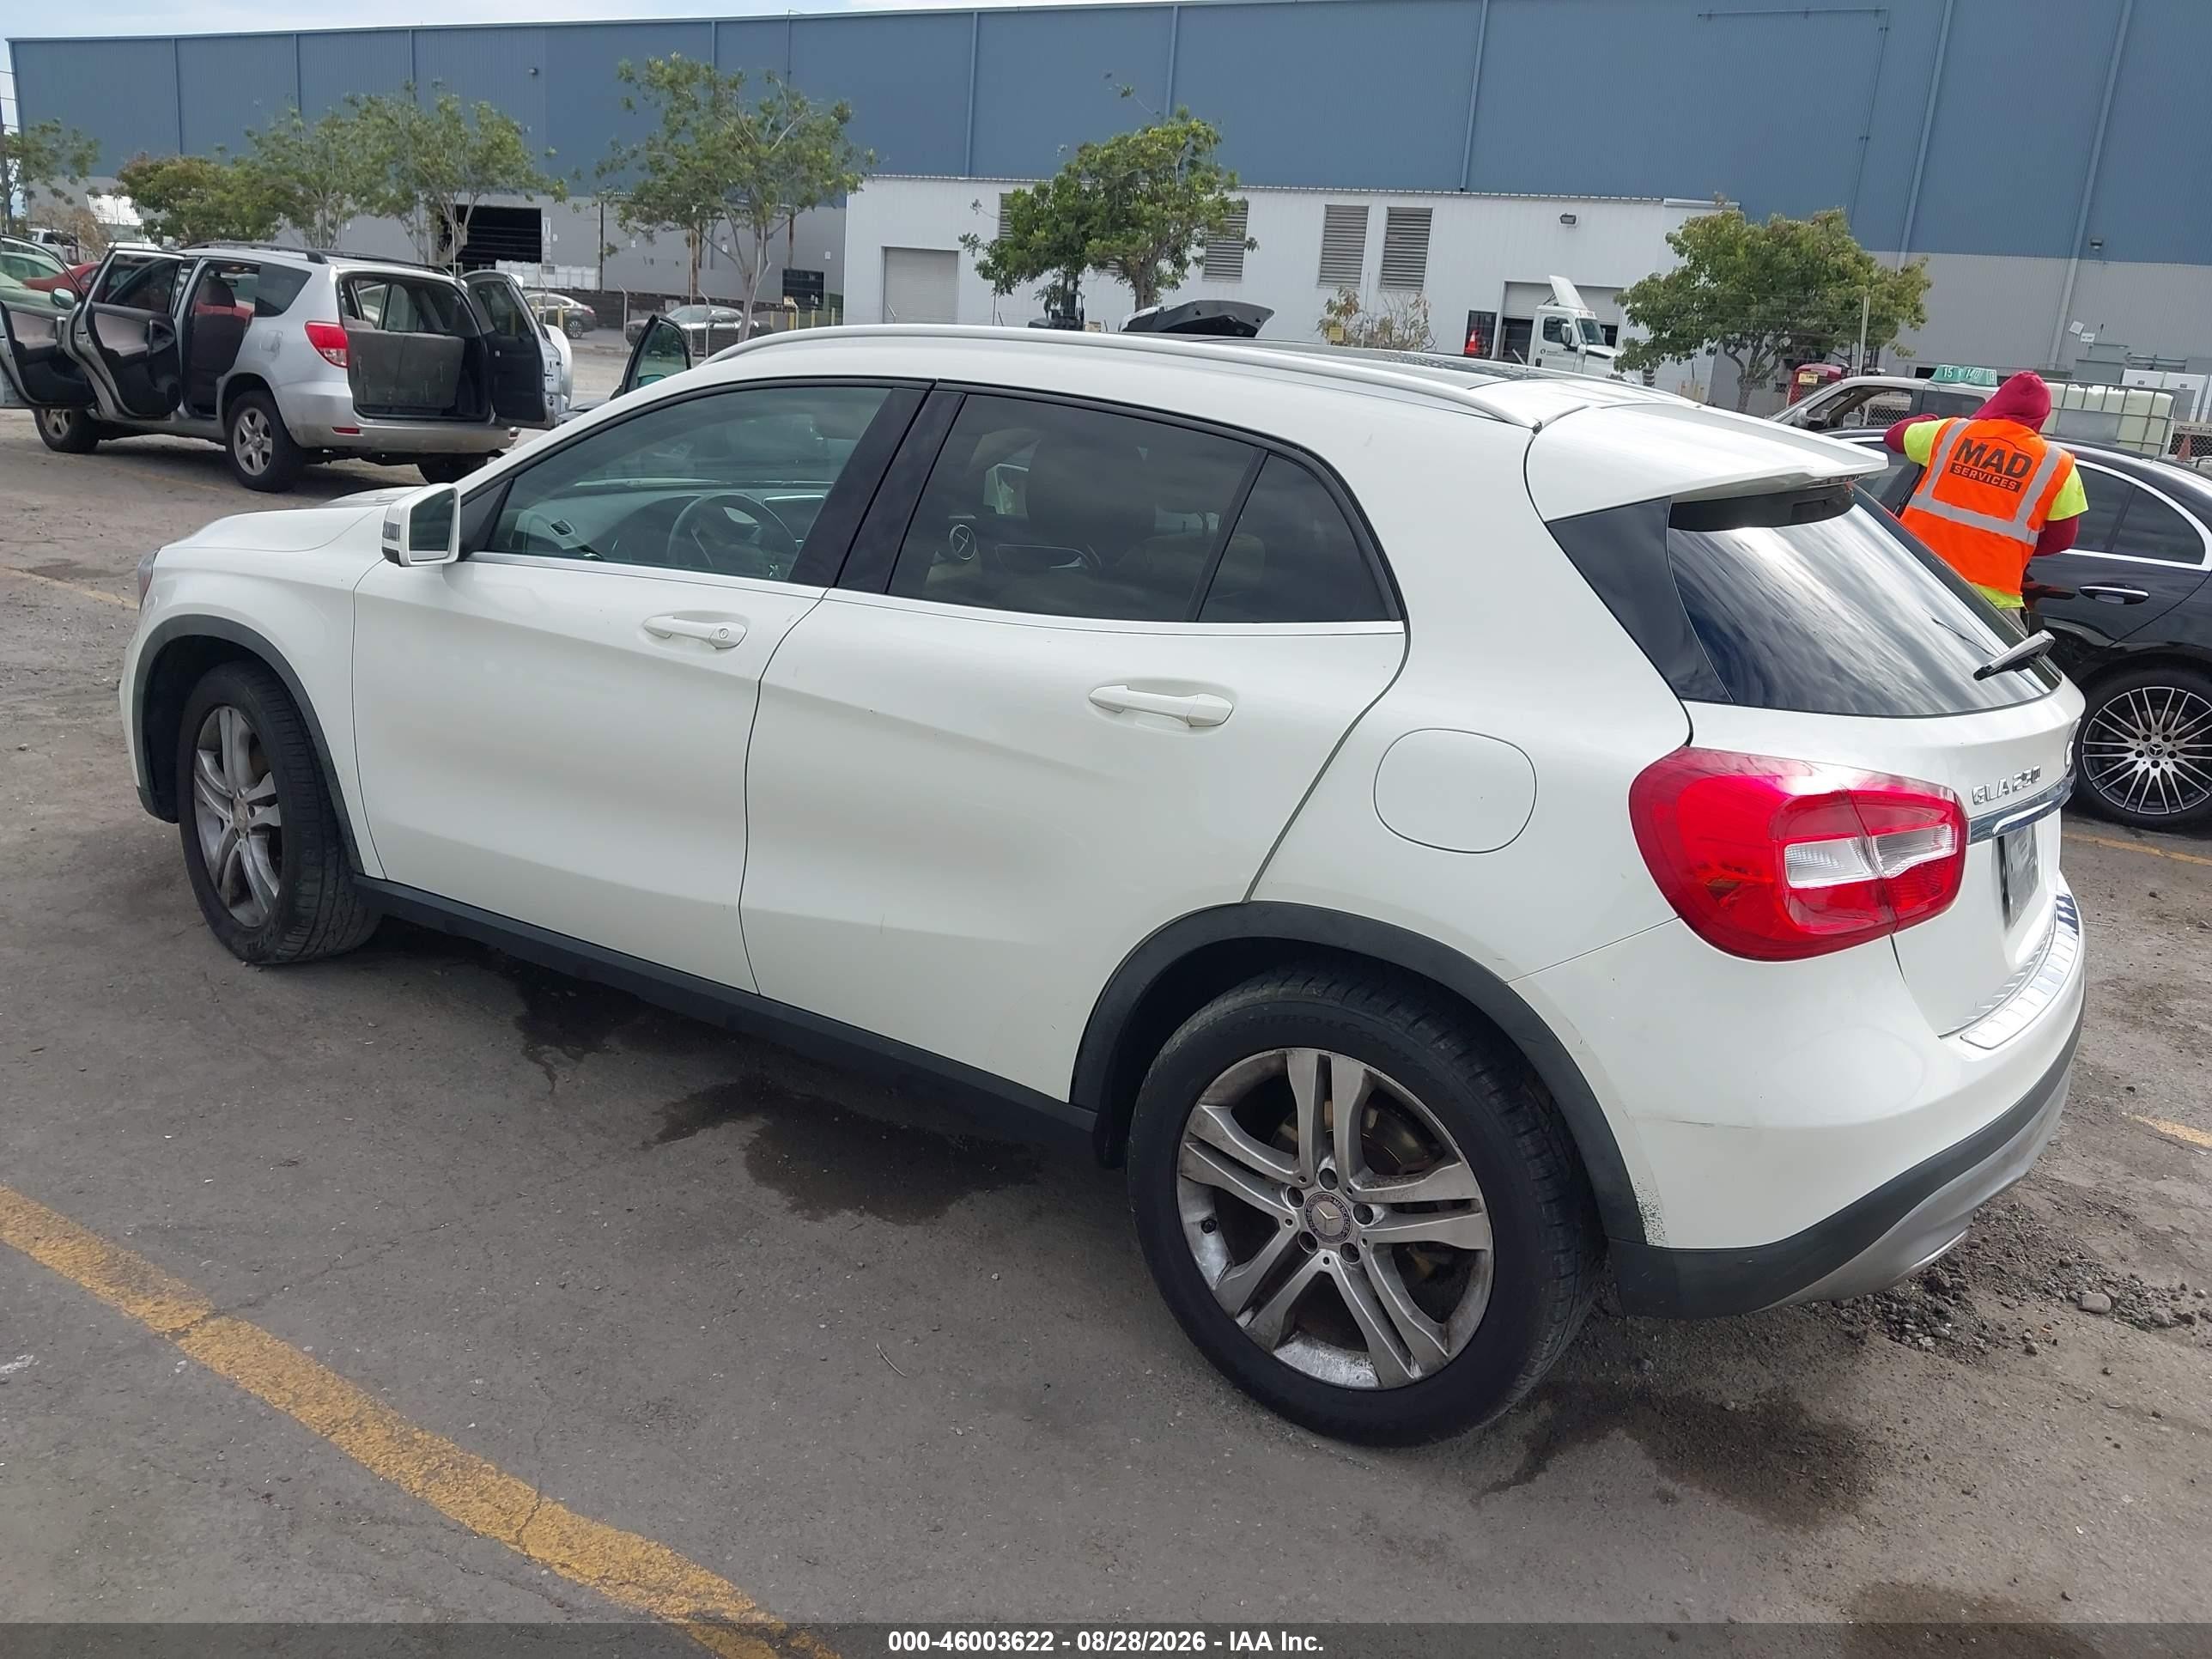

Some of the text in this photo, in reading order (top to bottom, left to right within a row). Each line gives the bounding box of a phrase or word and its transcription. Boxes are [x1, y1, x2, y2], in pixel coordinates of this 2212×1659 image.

[1943, 367, 1954, 379] 15
[1954, 437, 2033, 478] MAD
[1953, 465, 2018, 491] SERVICES
[1972, 777, 2010, 805] GLA
